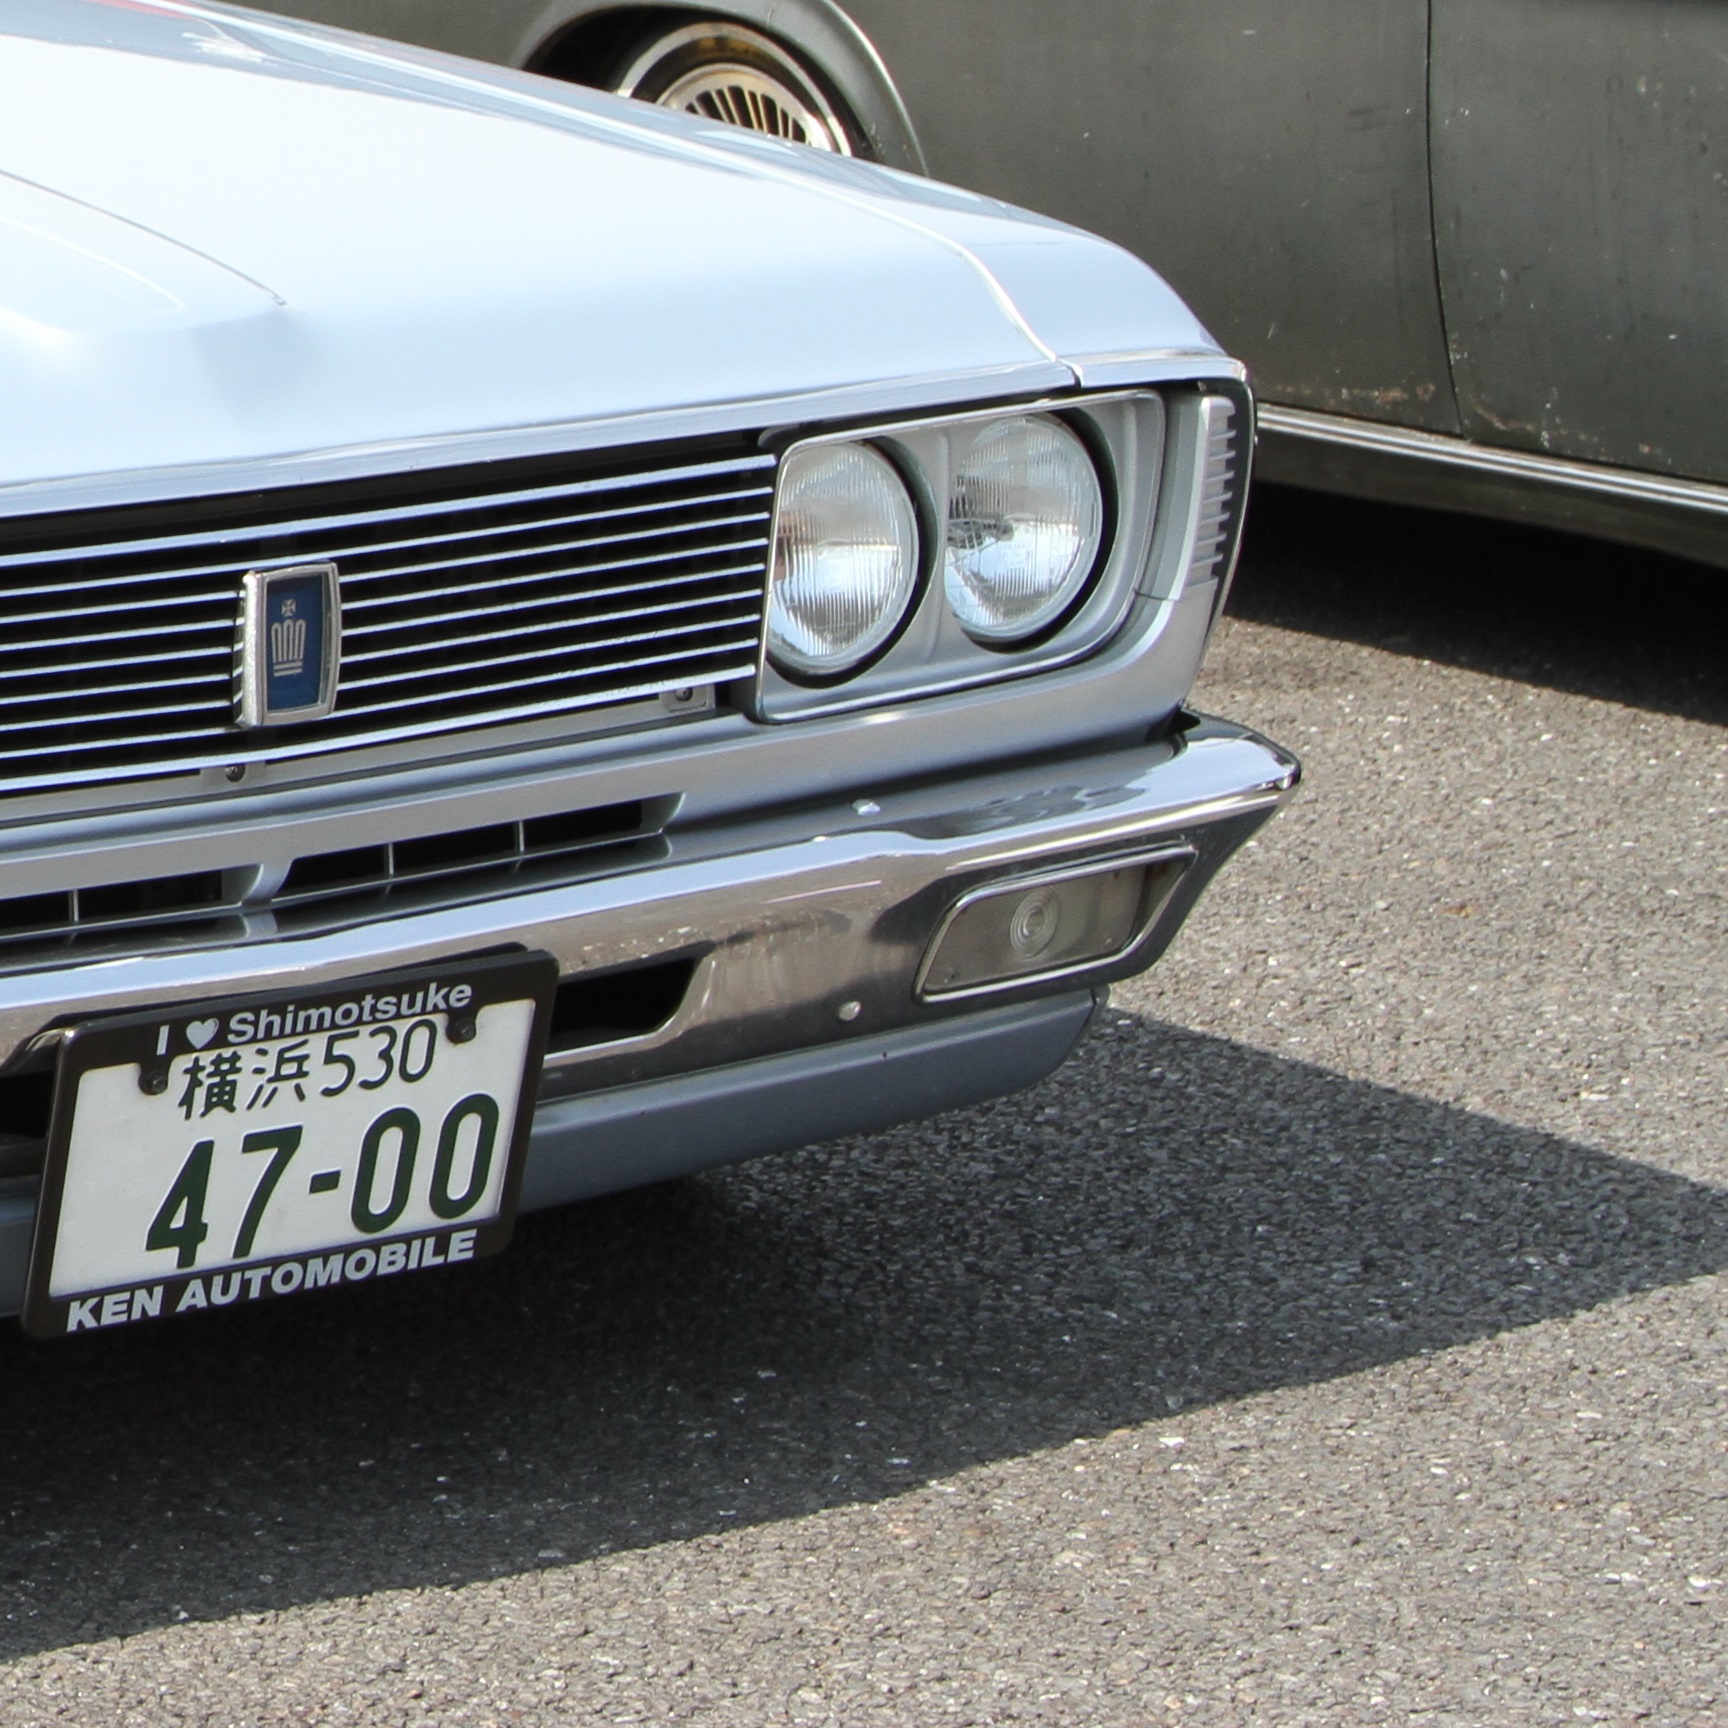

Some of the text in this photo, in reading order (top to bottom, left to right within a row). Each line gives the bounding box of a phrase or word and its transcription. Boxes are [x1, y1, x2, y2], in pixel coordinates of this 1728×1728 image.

[156, 982, 472, 1056] I Shimotsuke
[145, 1093, 500, 1269] 47-00
[66, 1229, 478, 1332] KEN AUTOMOBILE
